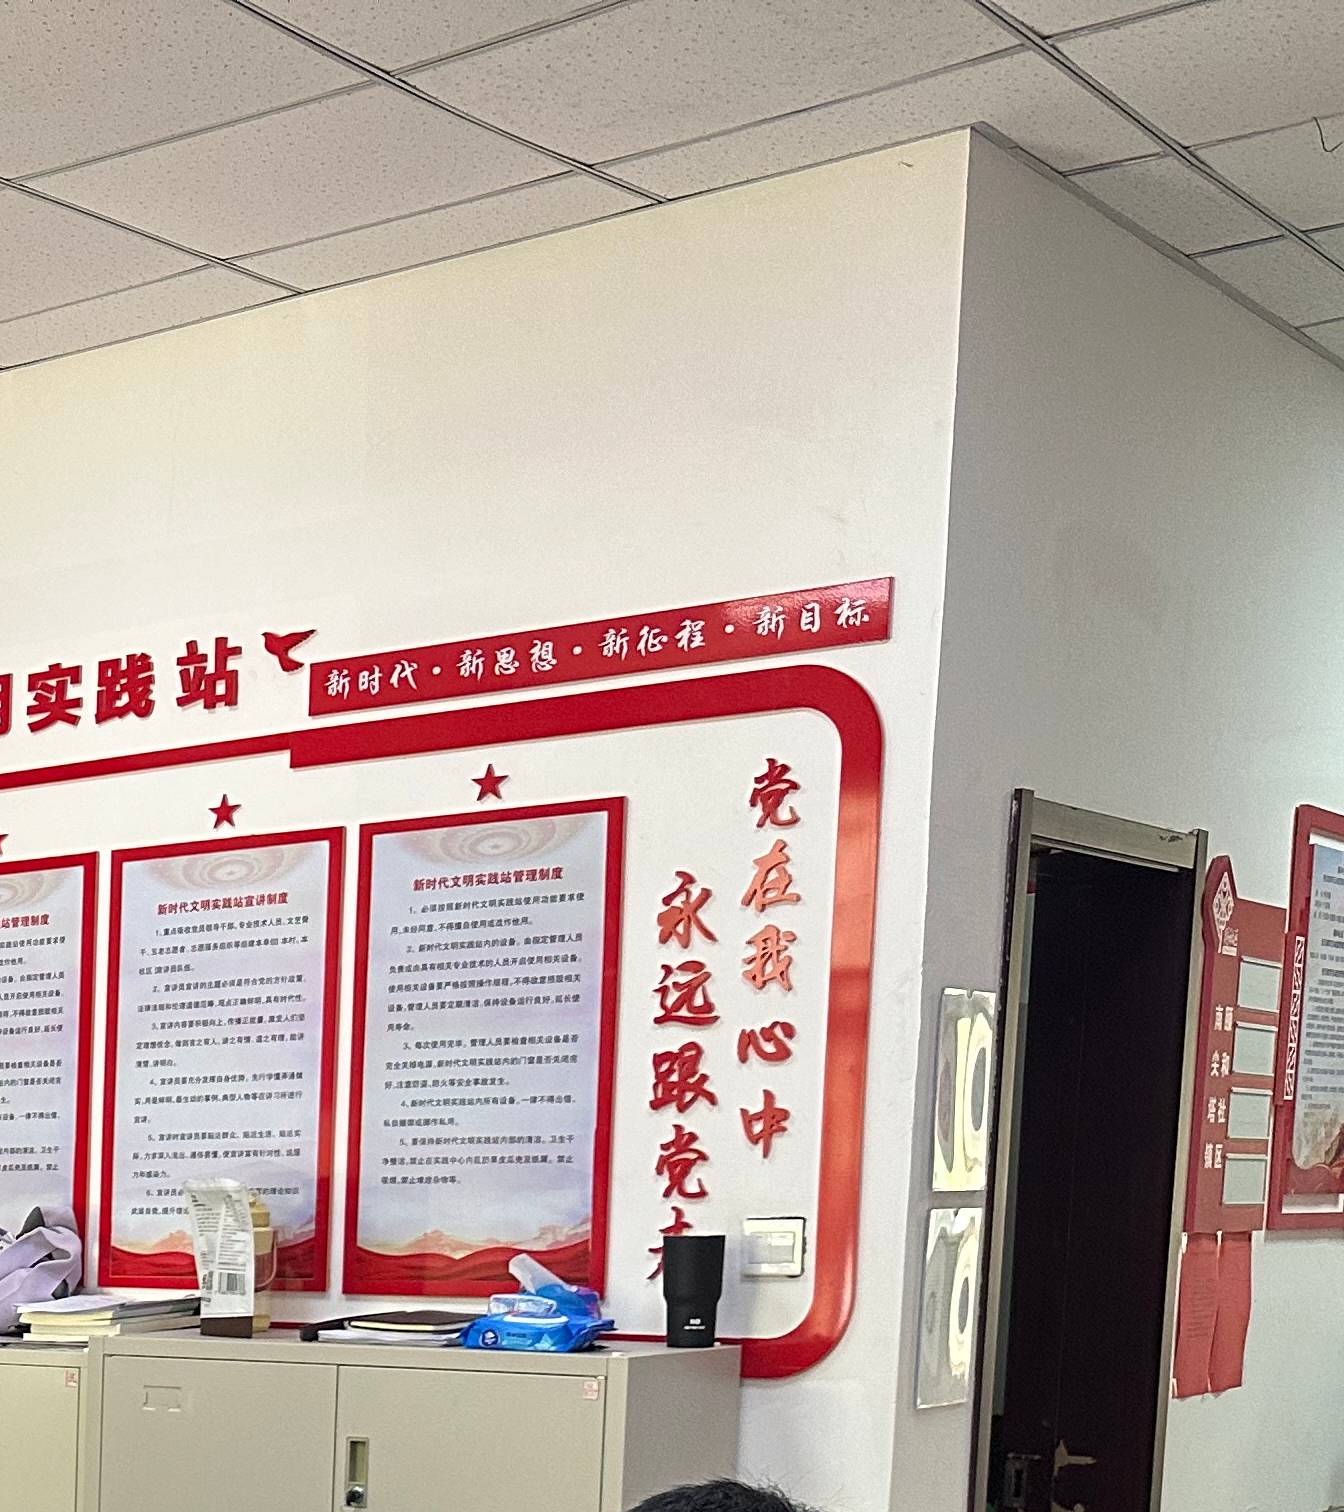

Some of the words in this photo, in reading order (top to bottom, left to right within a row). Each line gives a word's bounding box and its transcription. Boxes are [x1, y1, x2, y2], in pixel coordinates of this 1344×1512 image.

[412, 868, 564, 891] 新时代文明实践站管理制度
[157, 892, 289, 915] 新时代文明实践站宣讲制度
[736, 757, 800, 1160] 党在我心中
